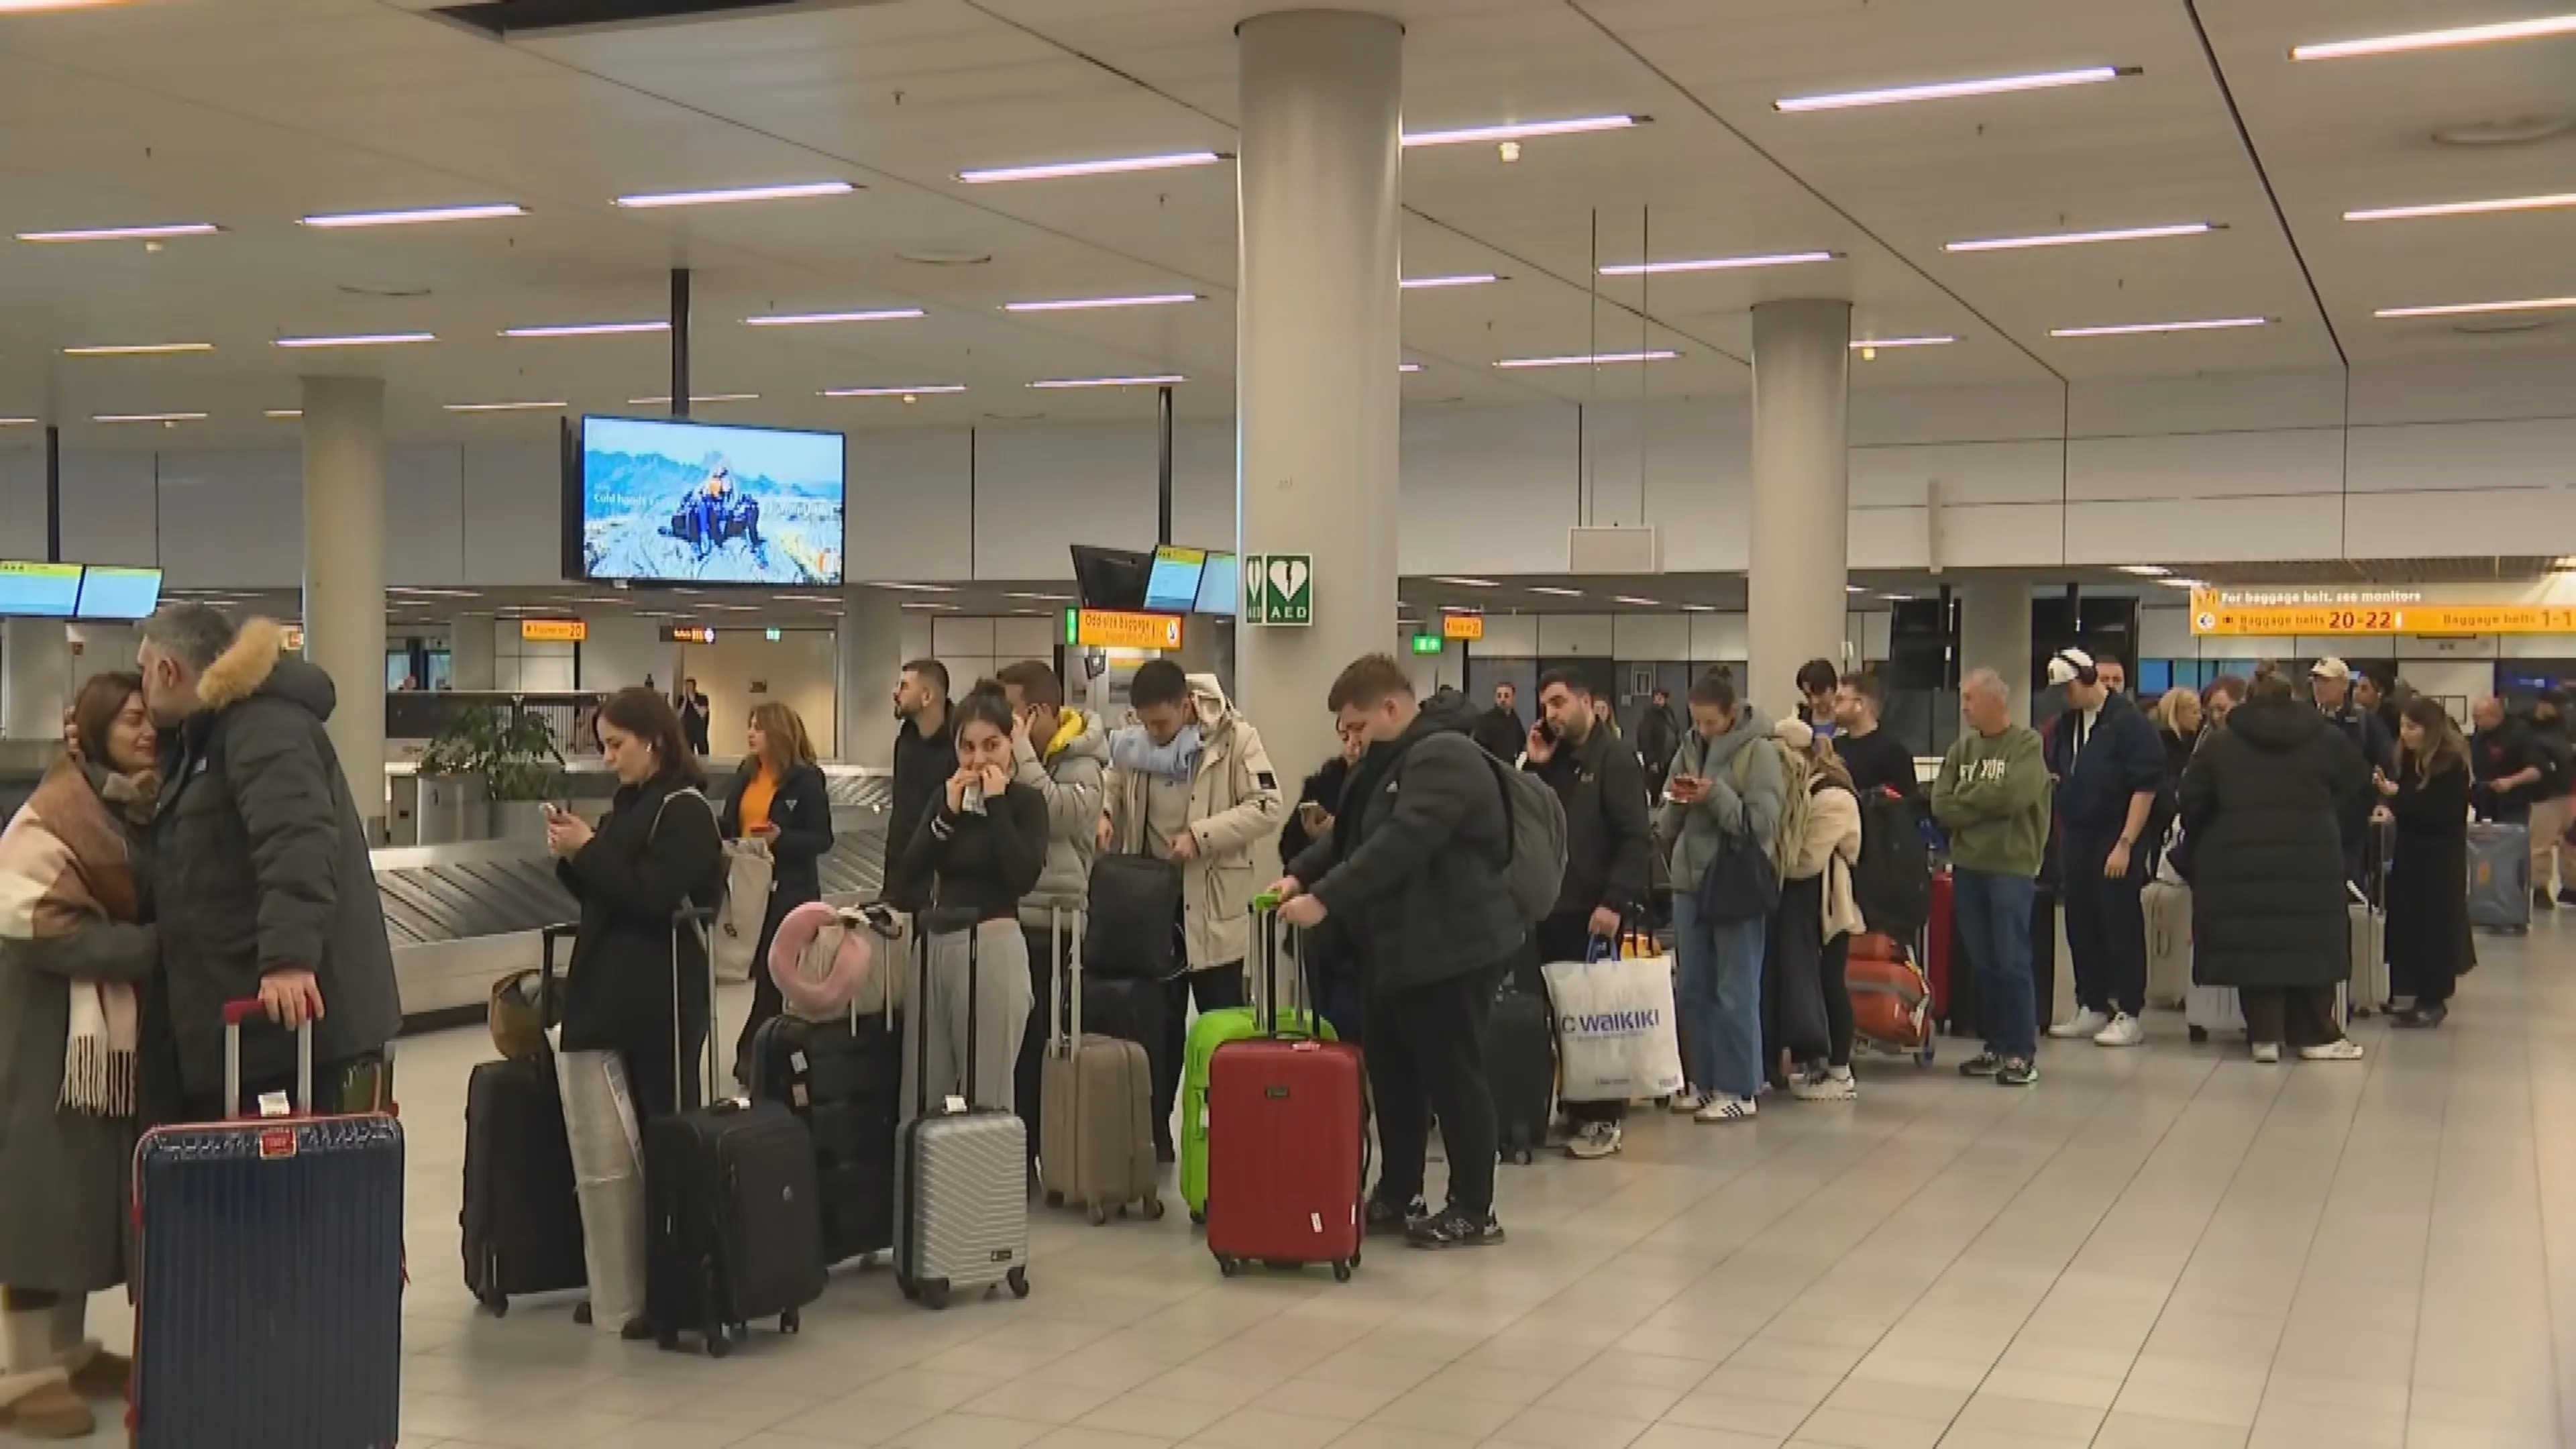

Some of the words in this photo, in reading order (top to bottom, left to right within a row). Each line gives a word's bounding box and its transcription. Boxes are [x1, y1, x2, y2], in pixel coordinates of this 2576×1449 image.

[2221, 590, 2241, 603] For
[2245, 590, 2300, 605] baggage
[2336, 592, 2359, 603] see
[2361, 590, 2422, 603] monitors
[1270, 605, 1307, 619] AED
[2240, 614, 2292, 627] Baggage
[2296, 614, 2324, 625] belts
[2443, 613, 2500, 627] Baggage
